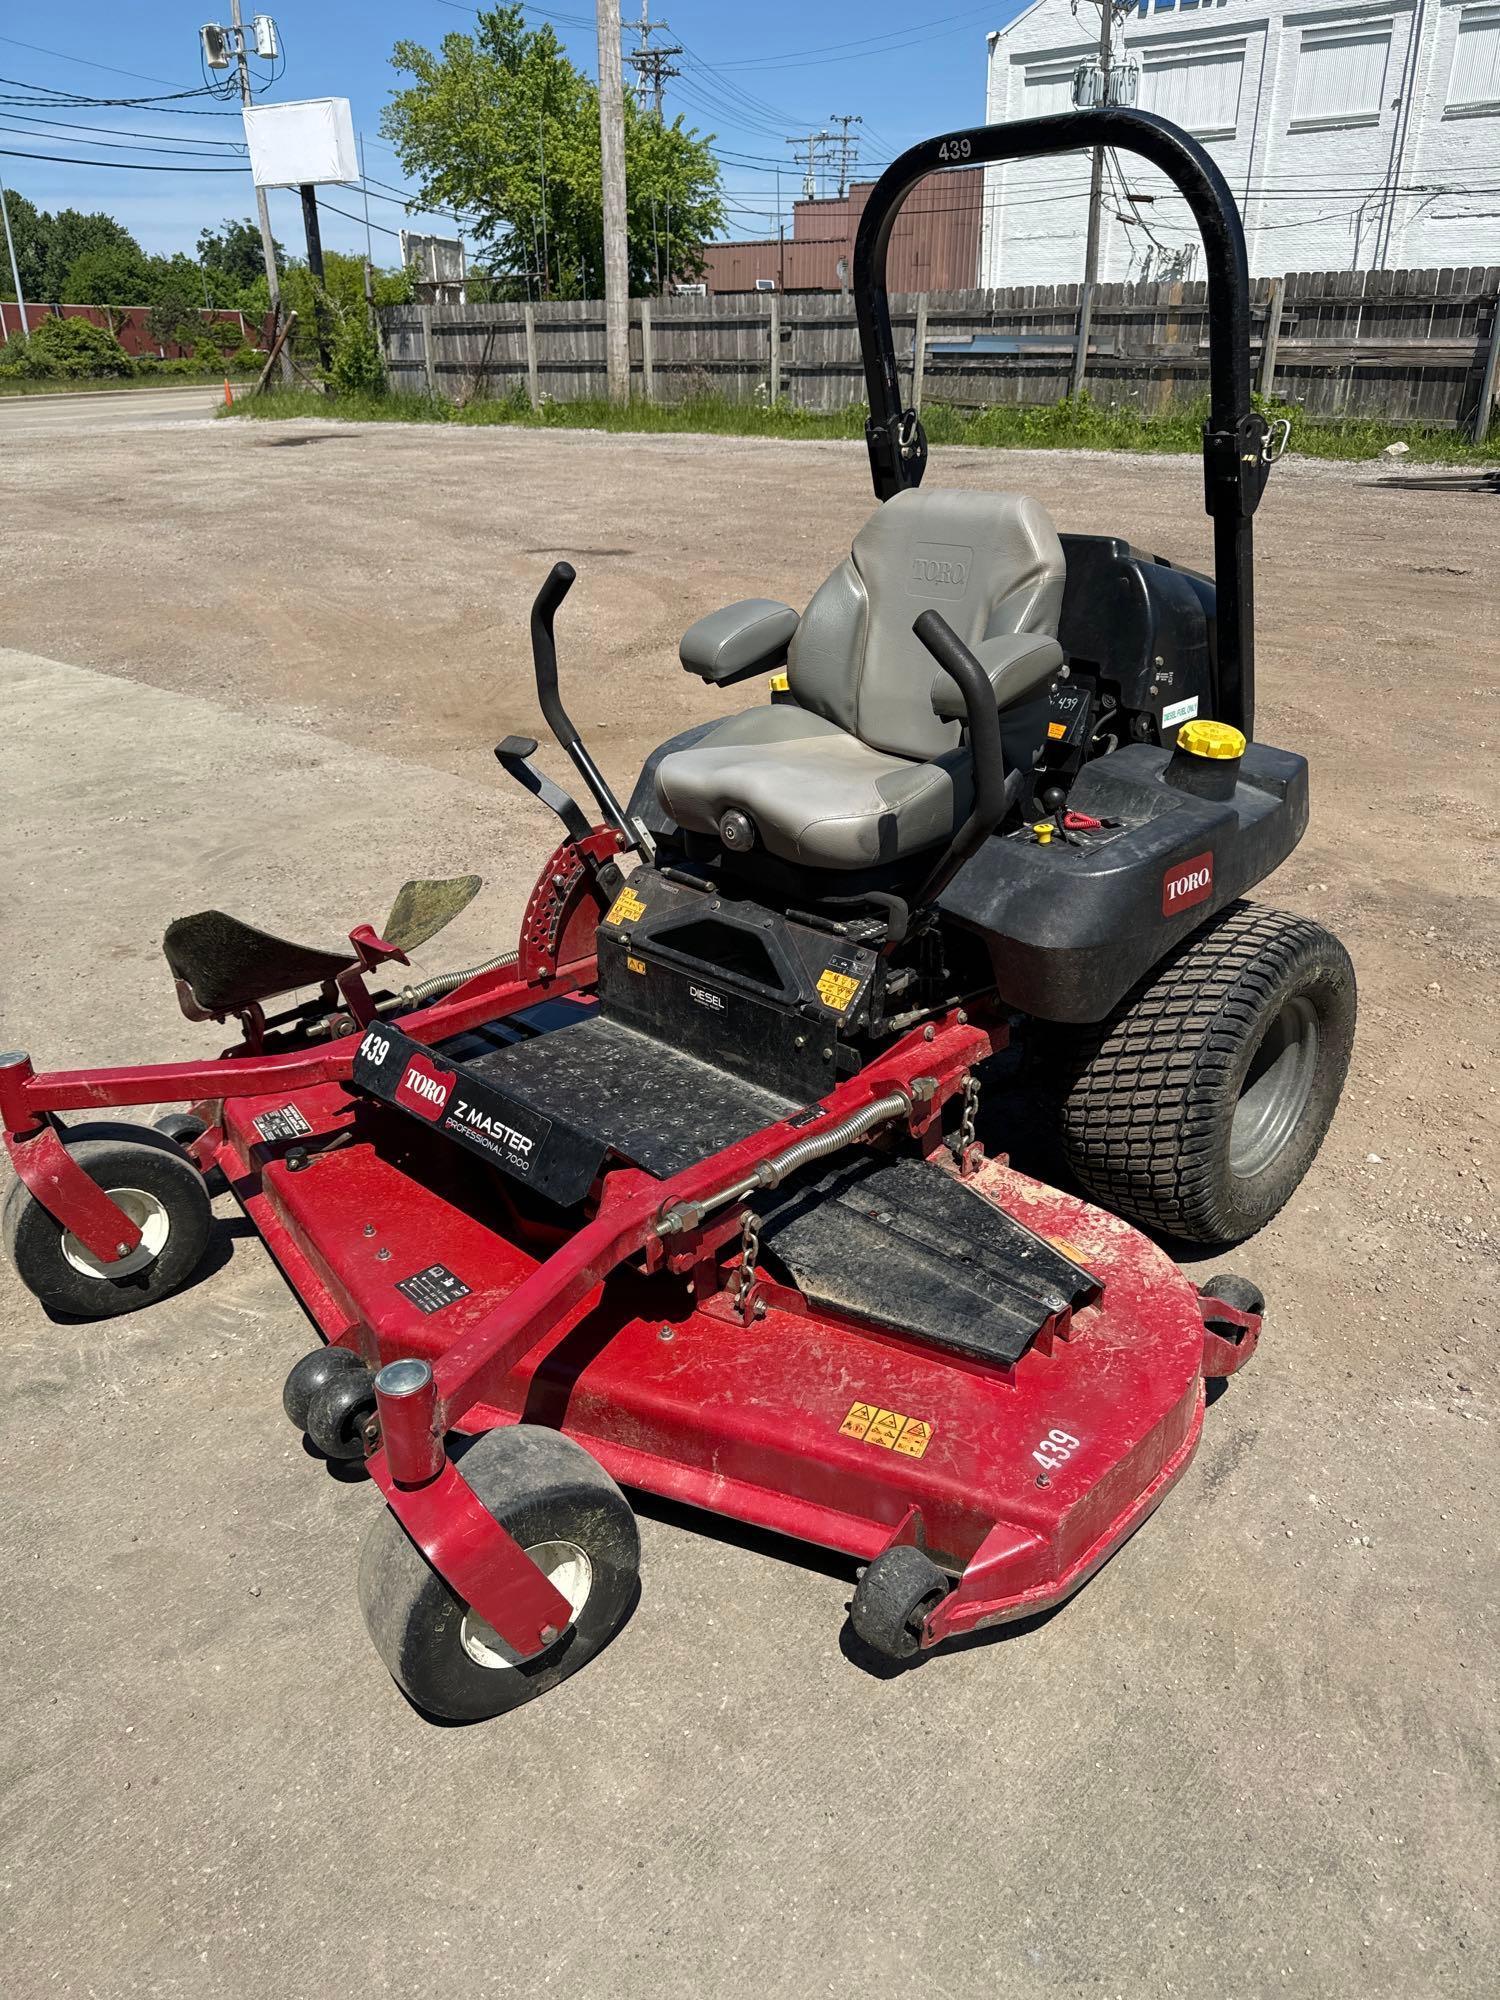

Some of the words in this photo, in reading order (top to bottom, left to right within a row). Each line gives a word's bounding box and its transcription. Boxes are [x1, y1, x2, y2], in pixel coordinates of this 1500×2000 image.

[938, 139, 972, 160] 439
[911, 558, 966, 585] TORO
[1058, 697, 1078, 711] 439
[1167, 867, 1210, 901] TORO
[690, 986, 725, 1009] DIESEL
[360, 1033, 390, 1065] 439
[405, 1068, 447, 1105] TORO
[445, 1117, 503, 1157] PROFESSIONAL
[505, 1151, 530, 1171] 7000
[454, 1100, 468, 1119] Z
[466, 1108, 533, 1156] MASTER
[1032, 1429, 1080, 1470] 439
